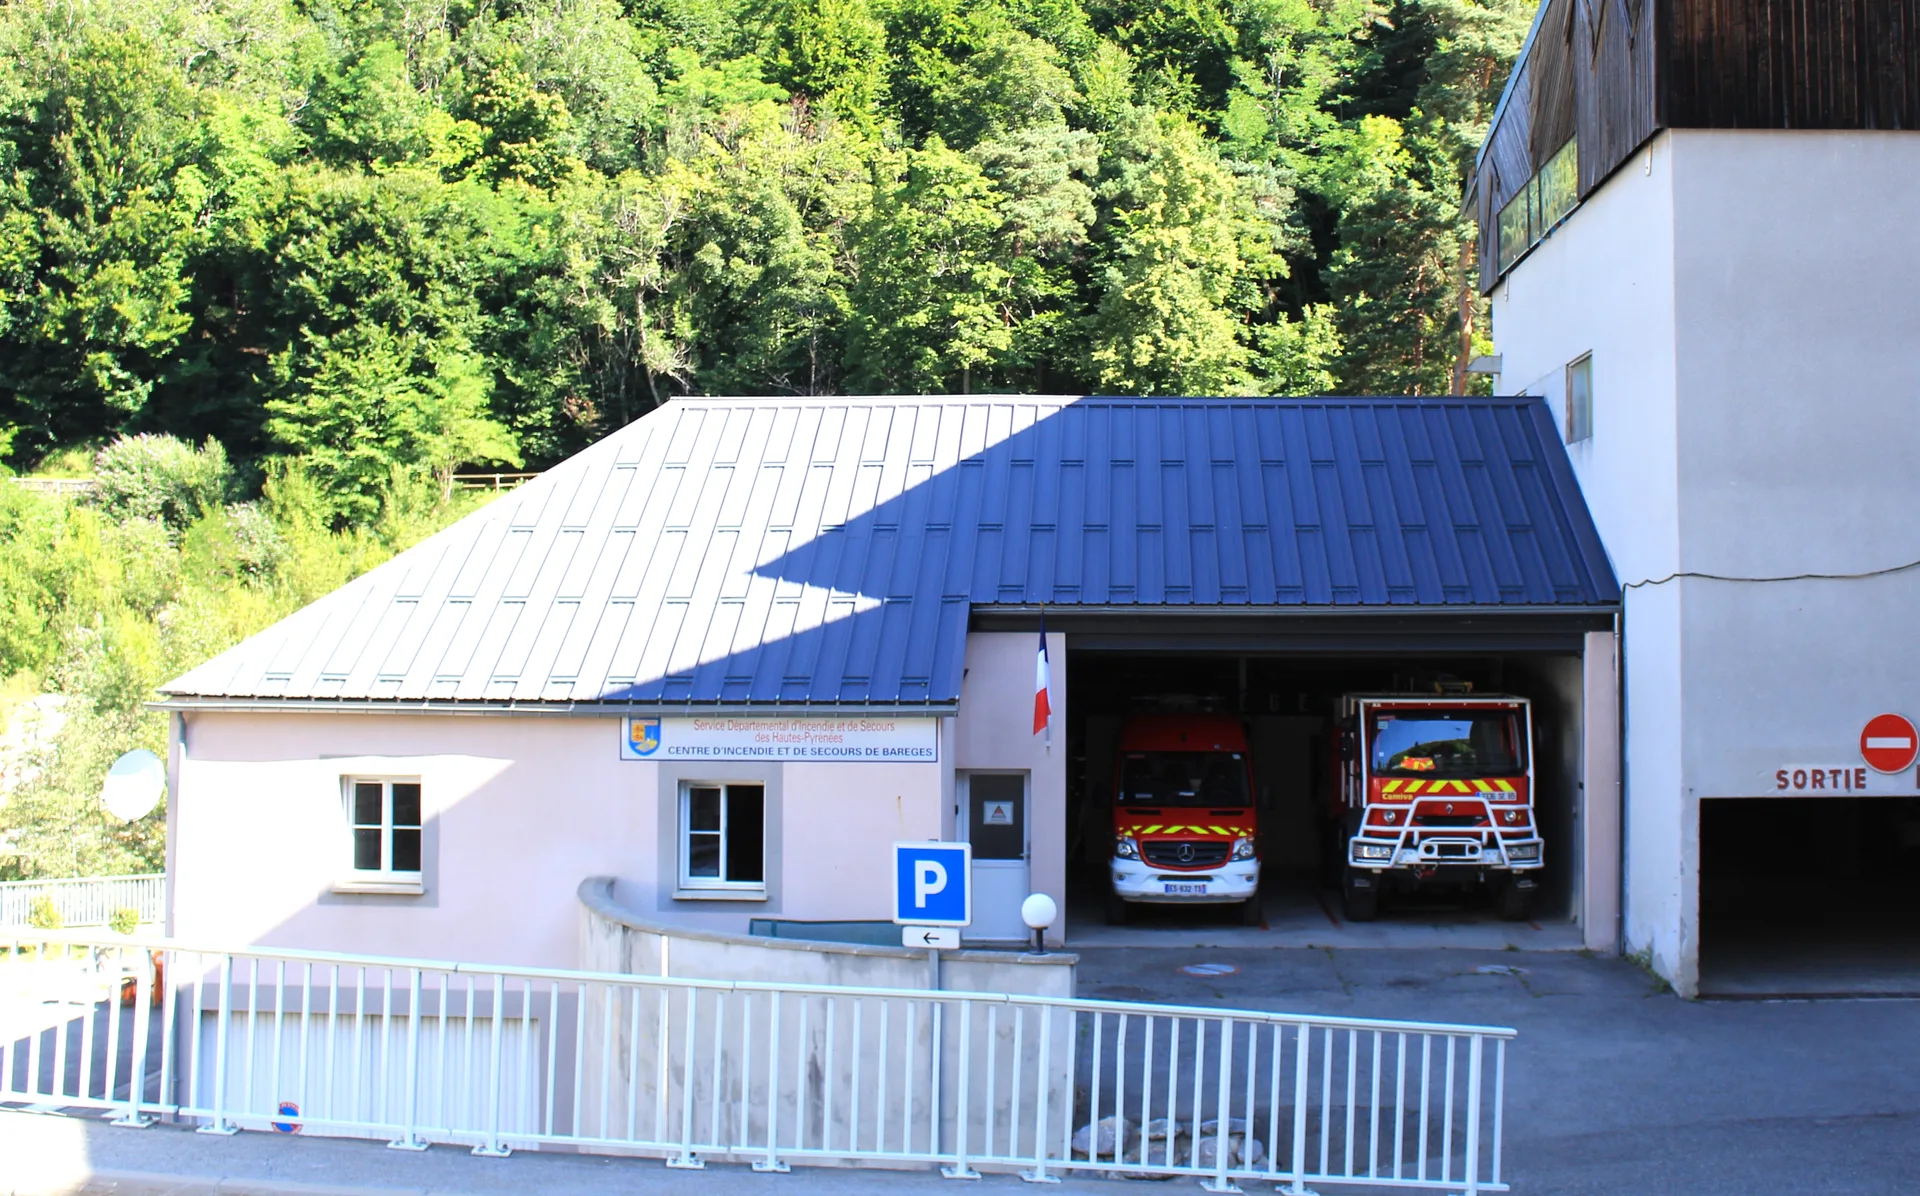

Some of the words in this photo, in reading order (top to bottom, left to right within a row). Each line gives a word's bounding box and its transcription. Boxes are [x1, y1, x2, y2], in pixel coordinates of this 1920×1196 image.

[694, 719, 725, 731] Service
[791, 719, 835, 732] d'Incendie
[837, 722, 846, 732] et
[847, 720, 858, 732] de
[860, 720, 895, 732] Secours
[755, 732, 770, 743] des
[668, 746, 710, 755] CENTRE
[713, 746, 775, 756] D'INCENDIE
[777, 747, 791, 756] ET
[794, 747, 807, 756] DE
[810, 747, 862, 756] SECOURS
[865, 747, 879, 756] DE
[882, 747, 933, 757] BAREGES
[1775, 768, 1867, 790] SORTIE
[915, 860, 947, 908] P
